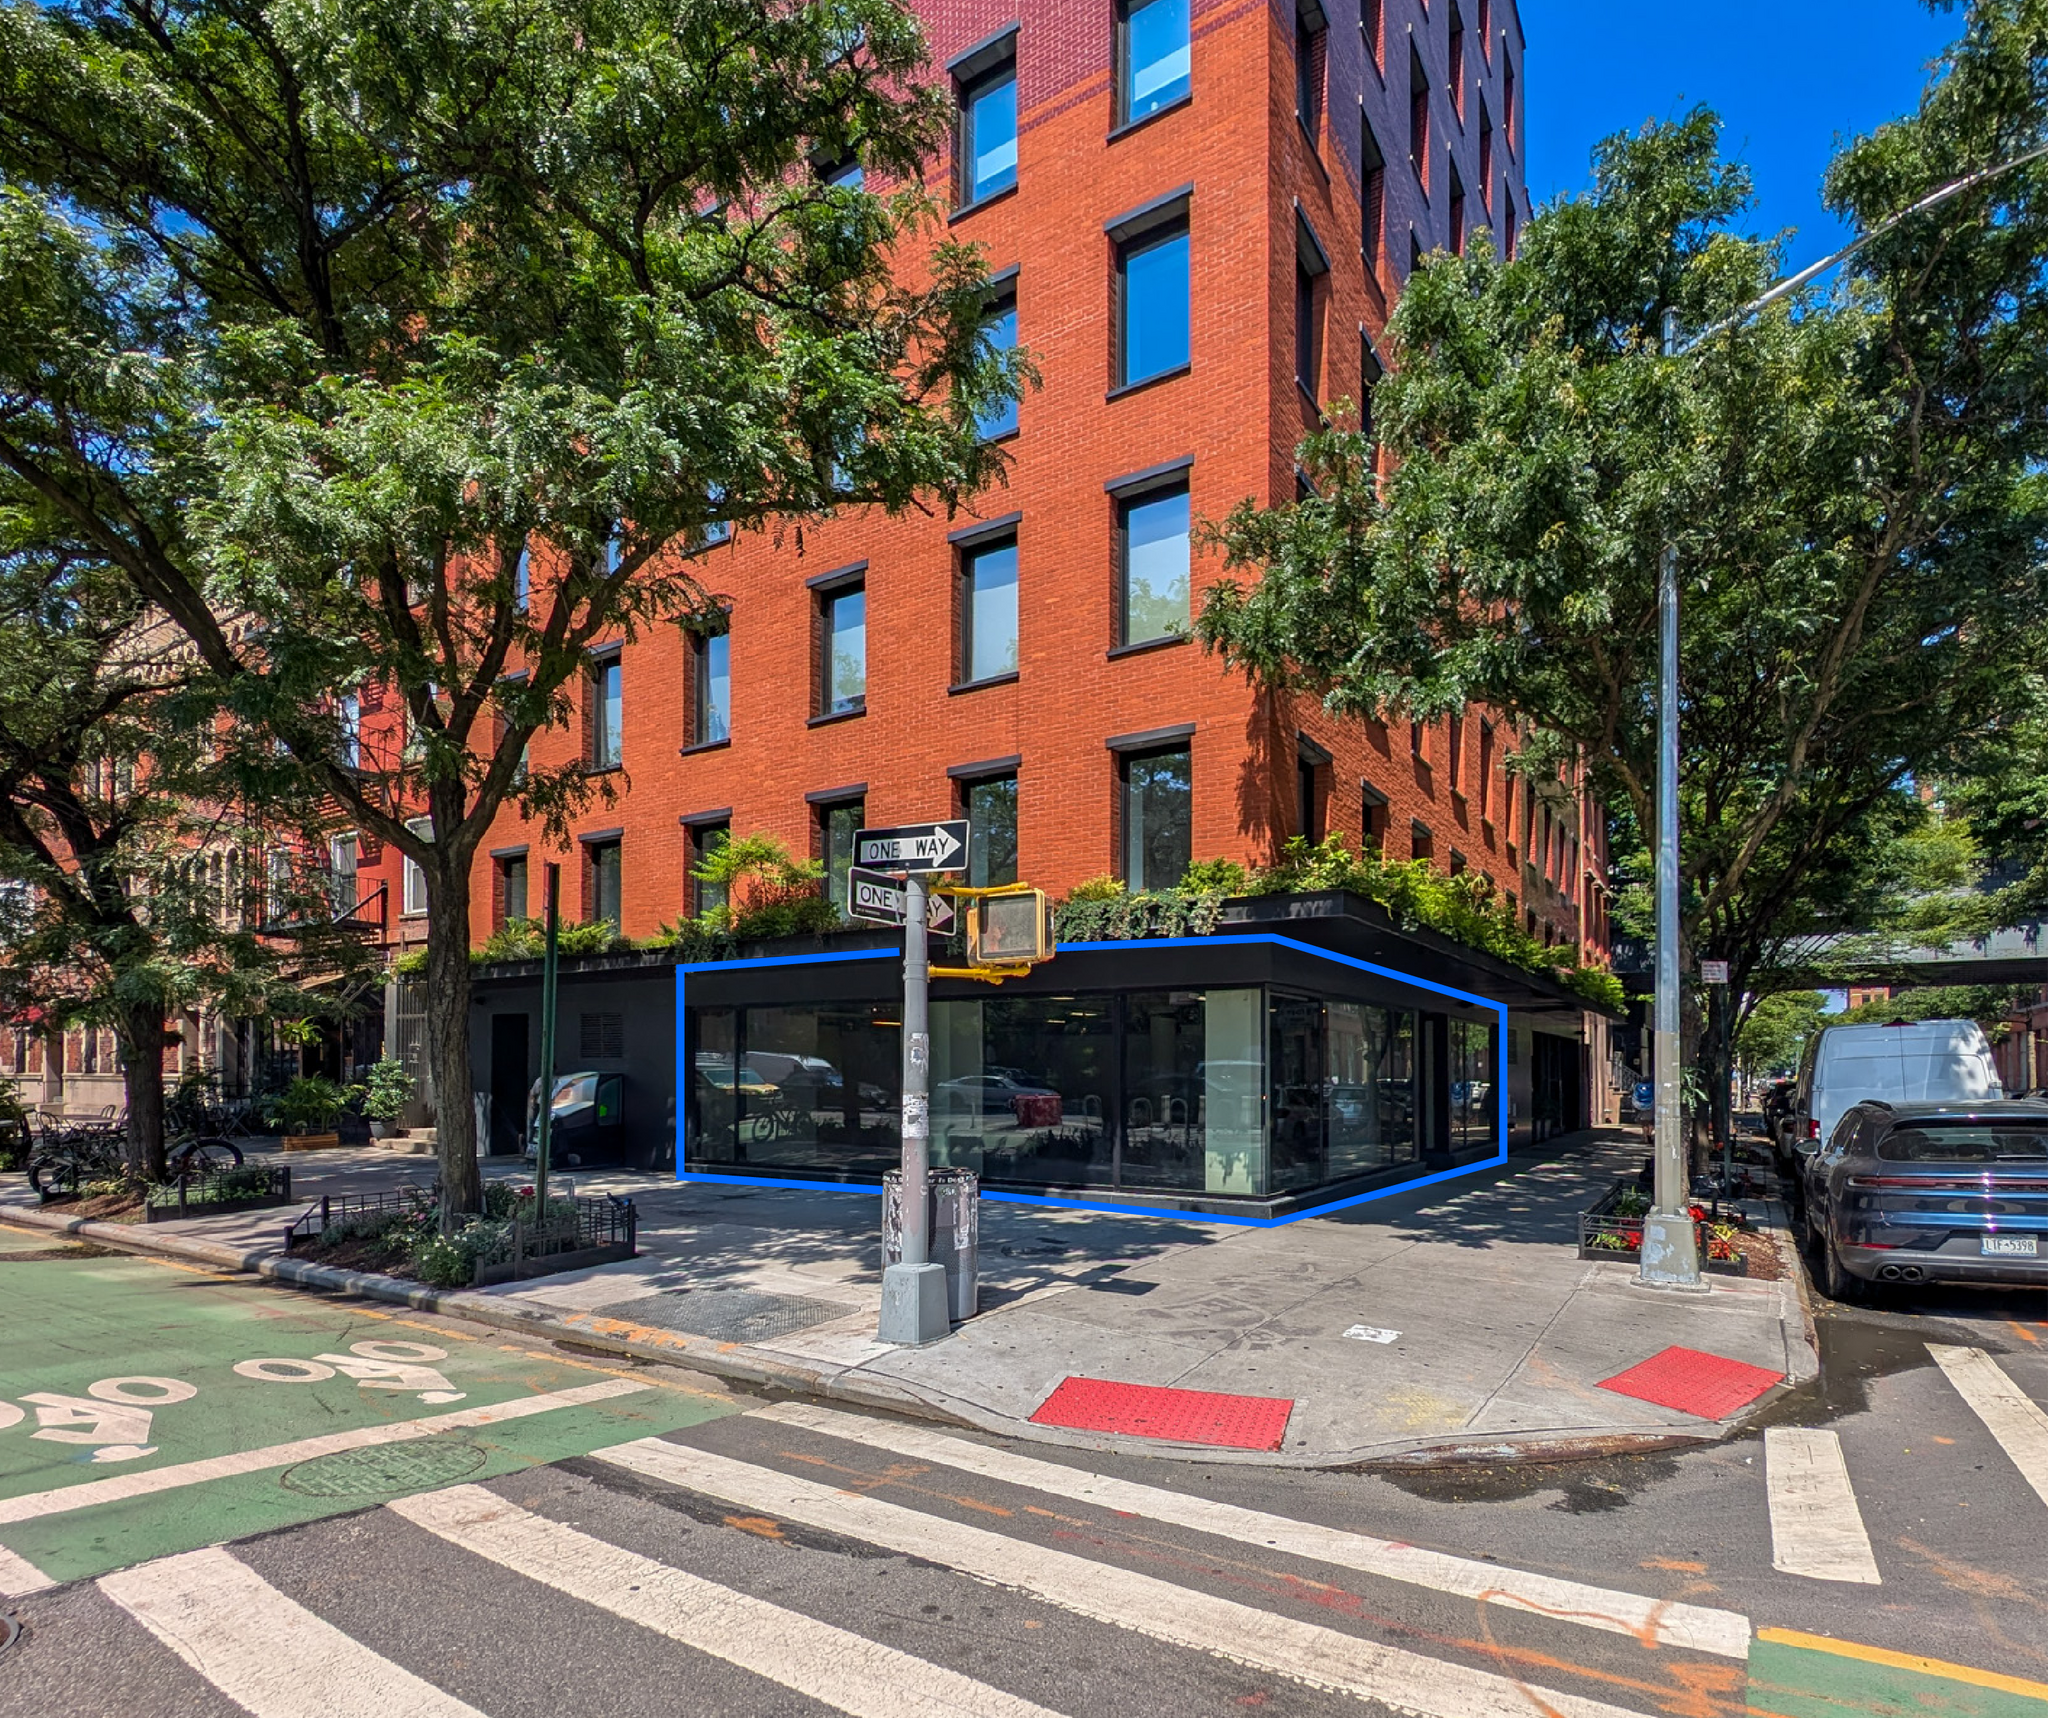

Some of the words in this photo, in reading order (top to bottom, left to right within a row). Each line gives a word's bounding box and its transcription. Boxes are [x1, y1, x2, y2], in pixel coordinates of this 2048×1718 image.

[869, 841, 900, 860] ONE
[916, 837, 950, 857] WAY
[860, 886, 893, 908] ONE
[926, 900, 942, 917] AY
